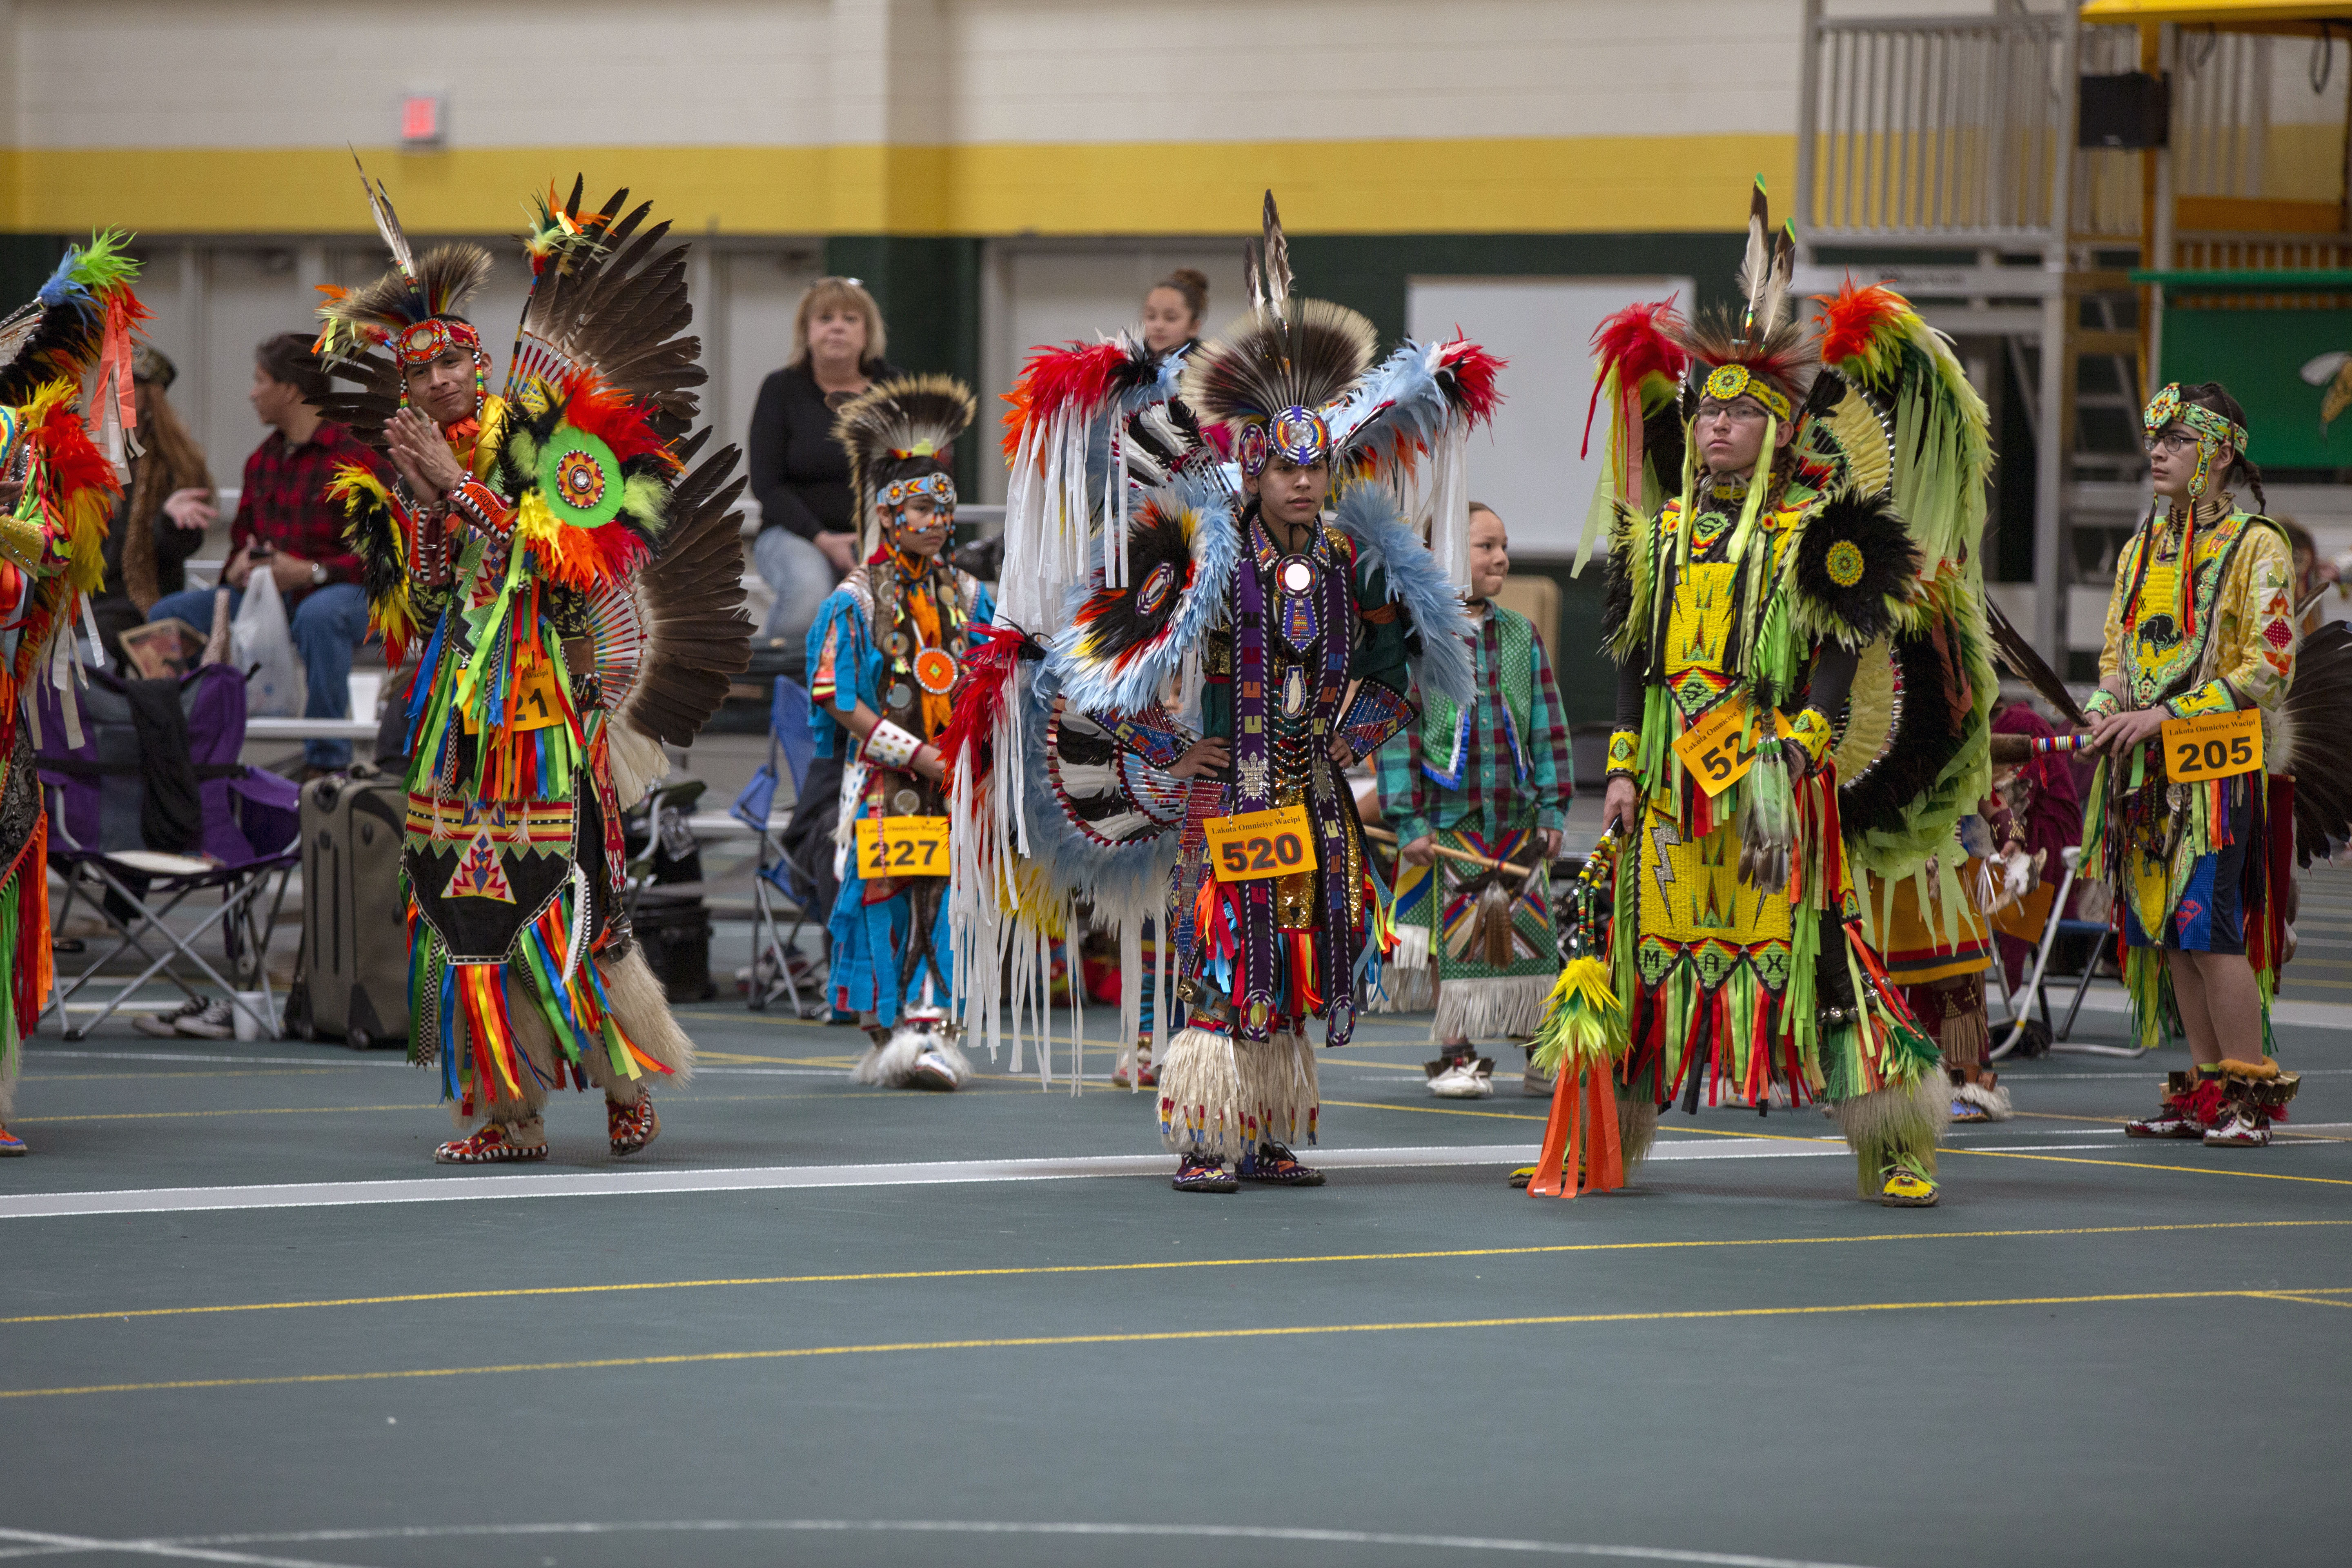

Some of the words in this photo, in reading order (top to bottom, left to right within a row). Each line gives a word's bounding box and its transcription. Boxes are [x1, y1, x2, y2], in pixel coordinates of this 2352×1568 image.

[472, 487, 502, 516] FROST
[527, 669, 548, 679] Wacipi
[1683, 735, 1707, 754] Lakota
[1707, 710, 1737, 735] Omniciye
[2169, 728, 2194, 736] Lakota
[2196, 724, 2229, 732] Omniciye
[2231, 719, 2256, 728] Wacipi
[2177, 736, 2252, 773] 205
[1212, 825, 1237, 834] Lakota
[1238, 821, 1273, 831] Omniciye
[1275, 815, 1301, 825] Wacipi
[869, 840, 938, 868] 227
[1221, 832, 1304, 873] 520
